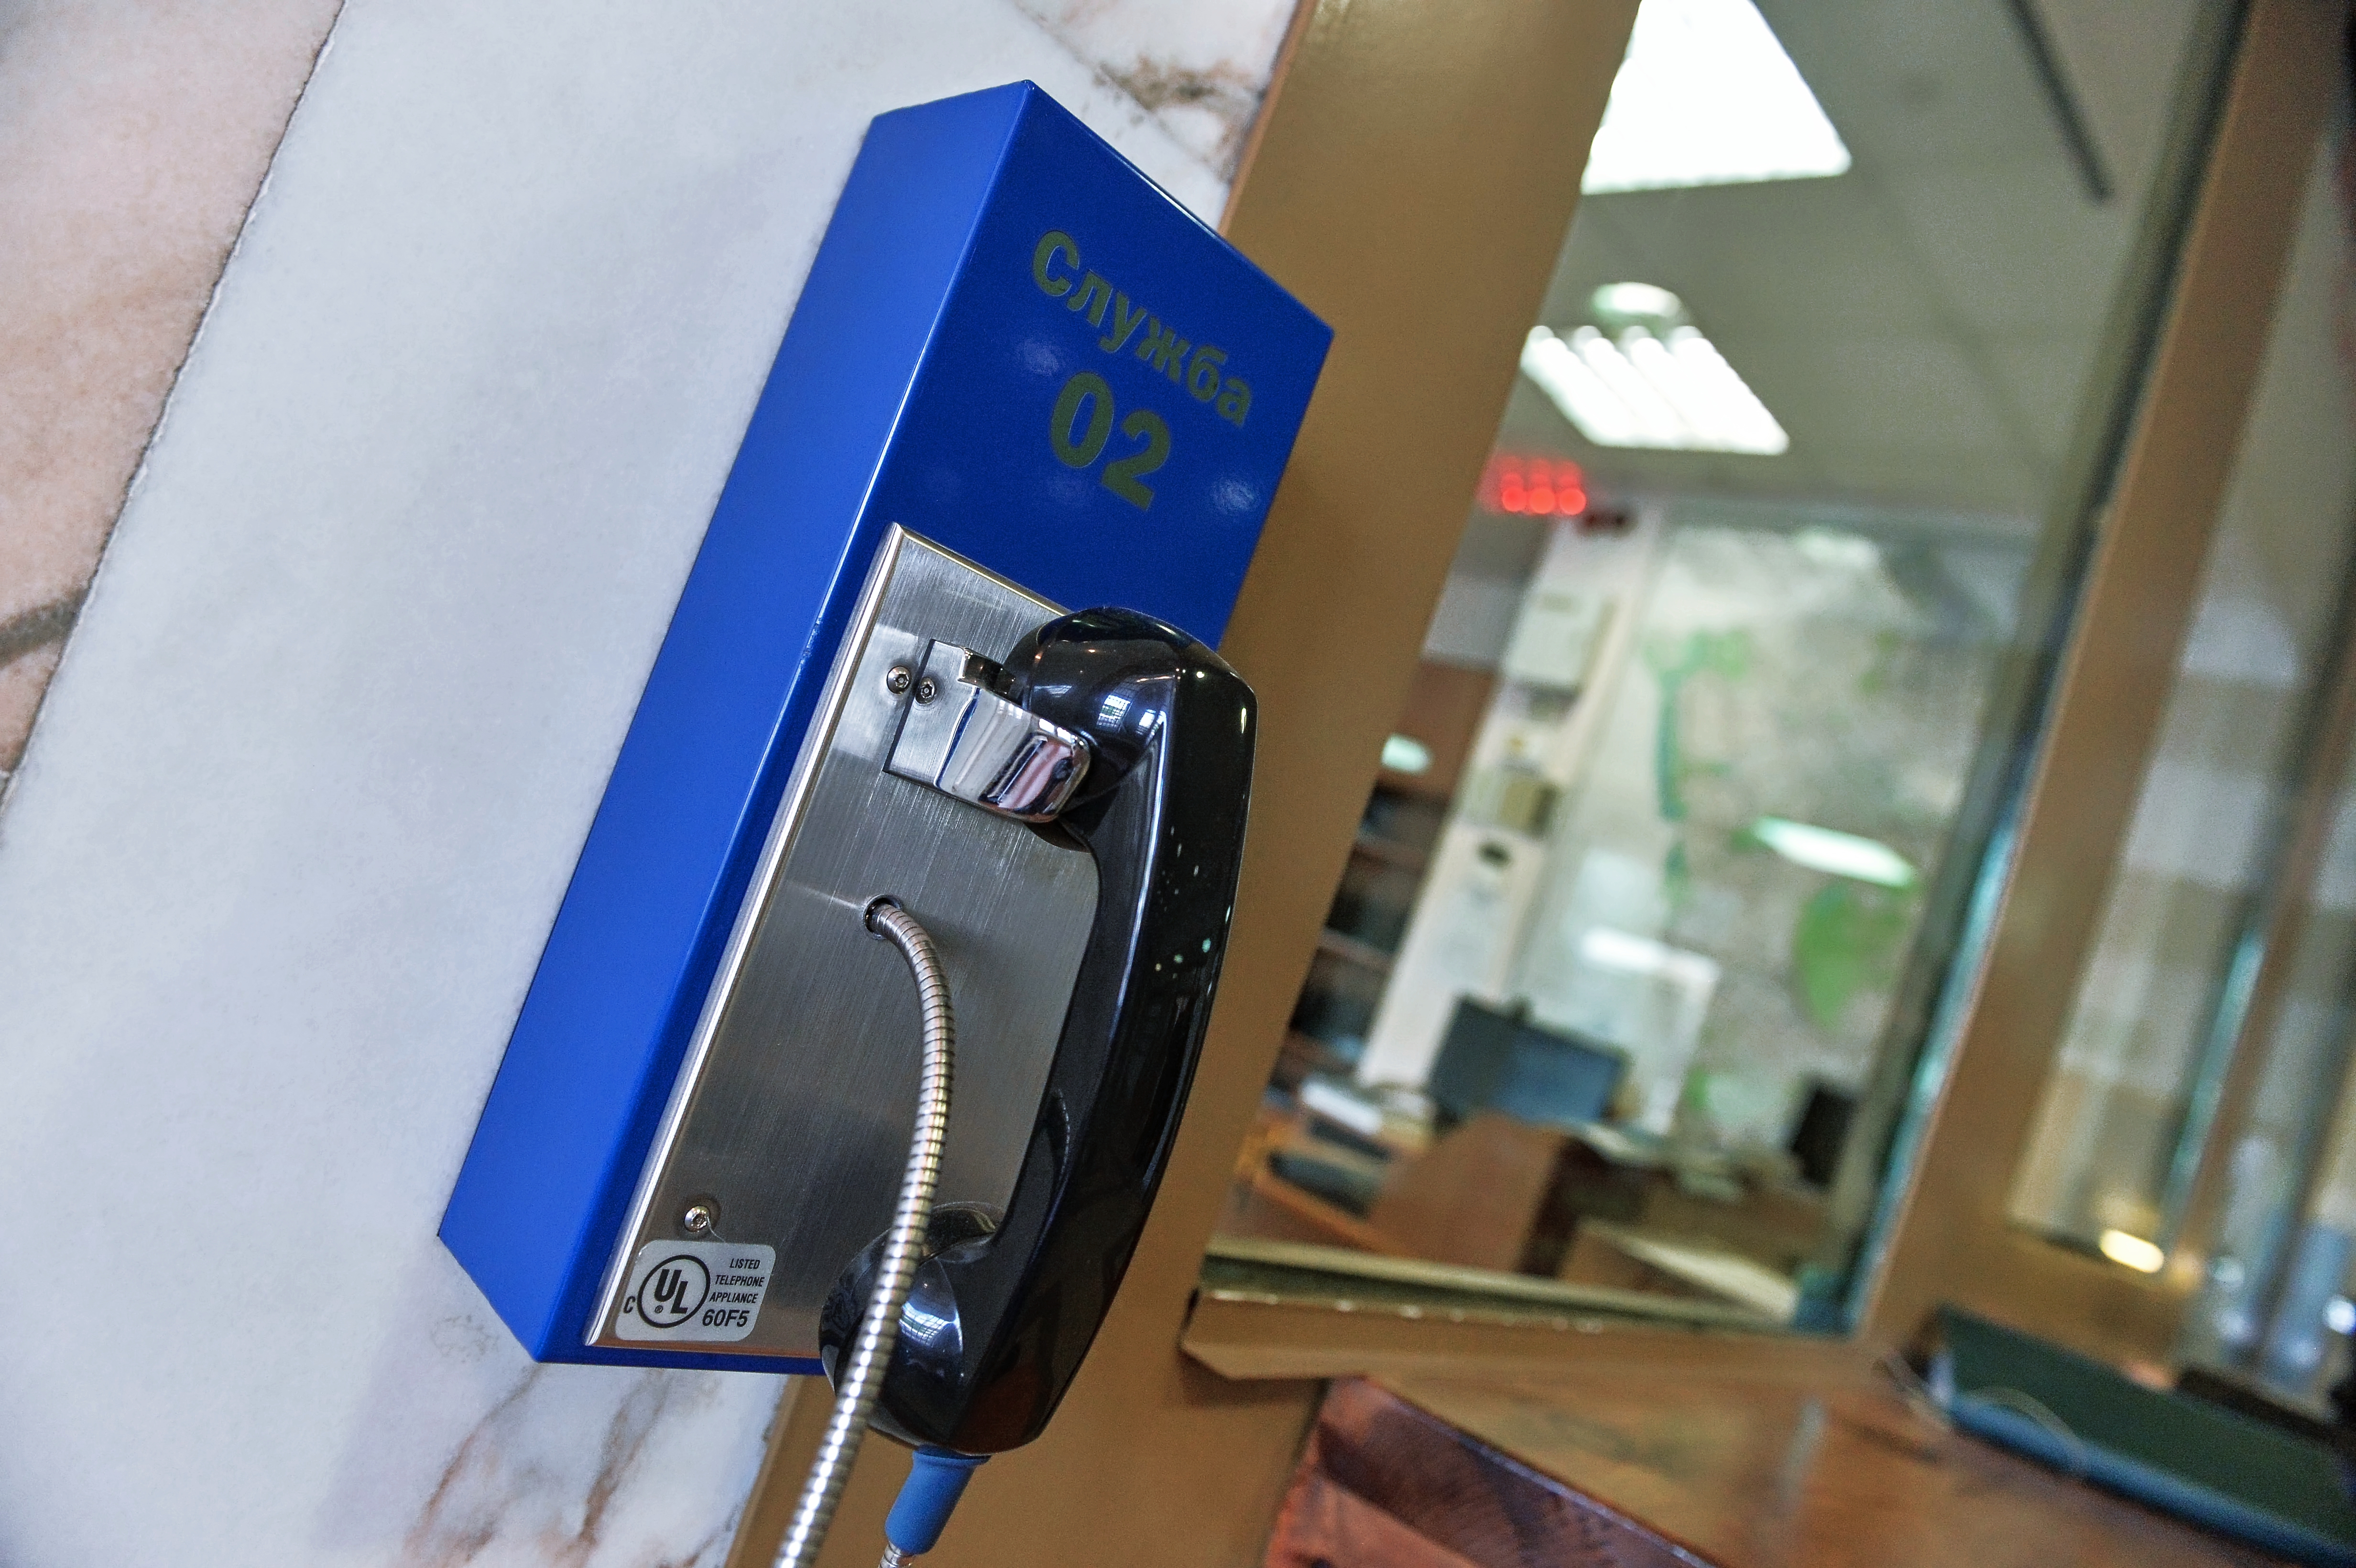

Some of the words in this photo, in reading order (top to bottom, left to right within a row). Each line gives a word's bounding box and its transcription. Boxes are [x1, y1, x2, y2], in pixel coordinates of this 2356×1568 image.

[1033, 230, 1251, 426] Служба
[1051, 372, 1170, 511] 02
[730, 1258, 761, 1269] LISTED
[715, 1275, 765, 1287] TELEPHONE
[654, 1269, 688, 1314] UL
[709, 1292, 758, 1304] APPLIANCE
[702, 1309, 750, 1327] 60F5
